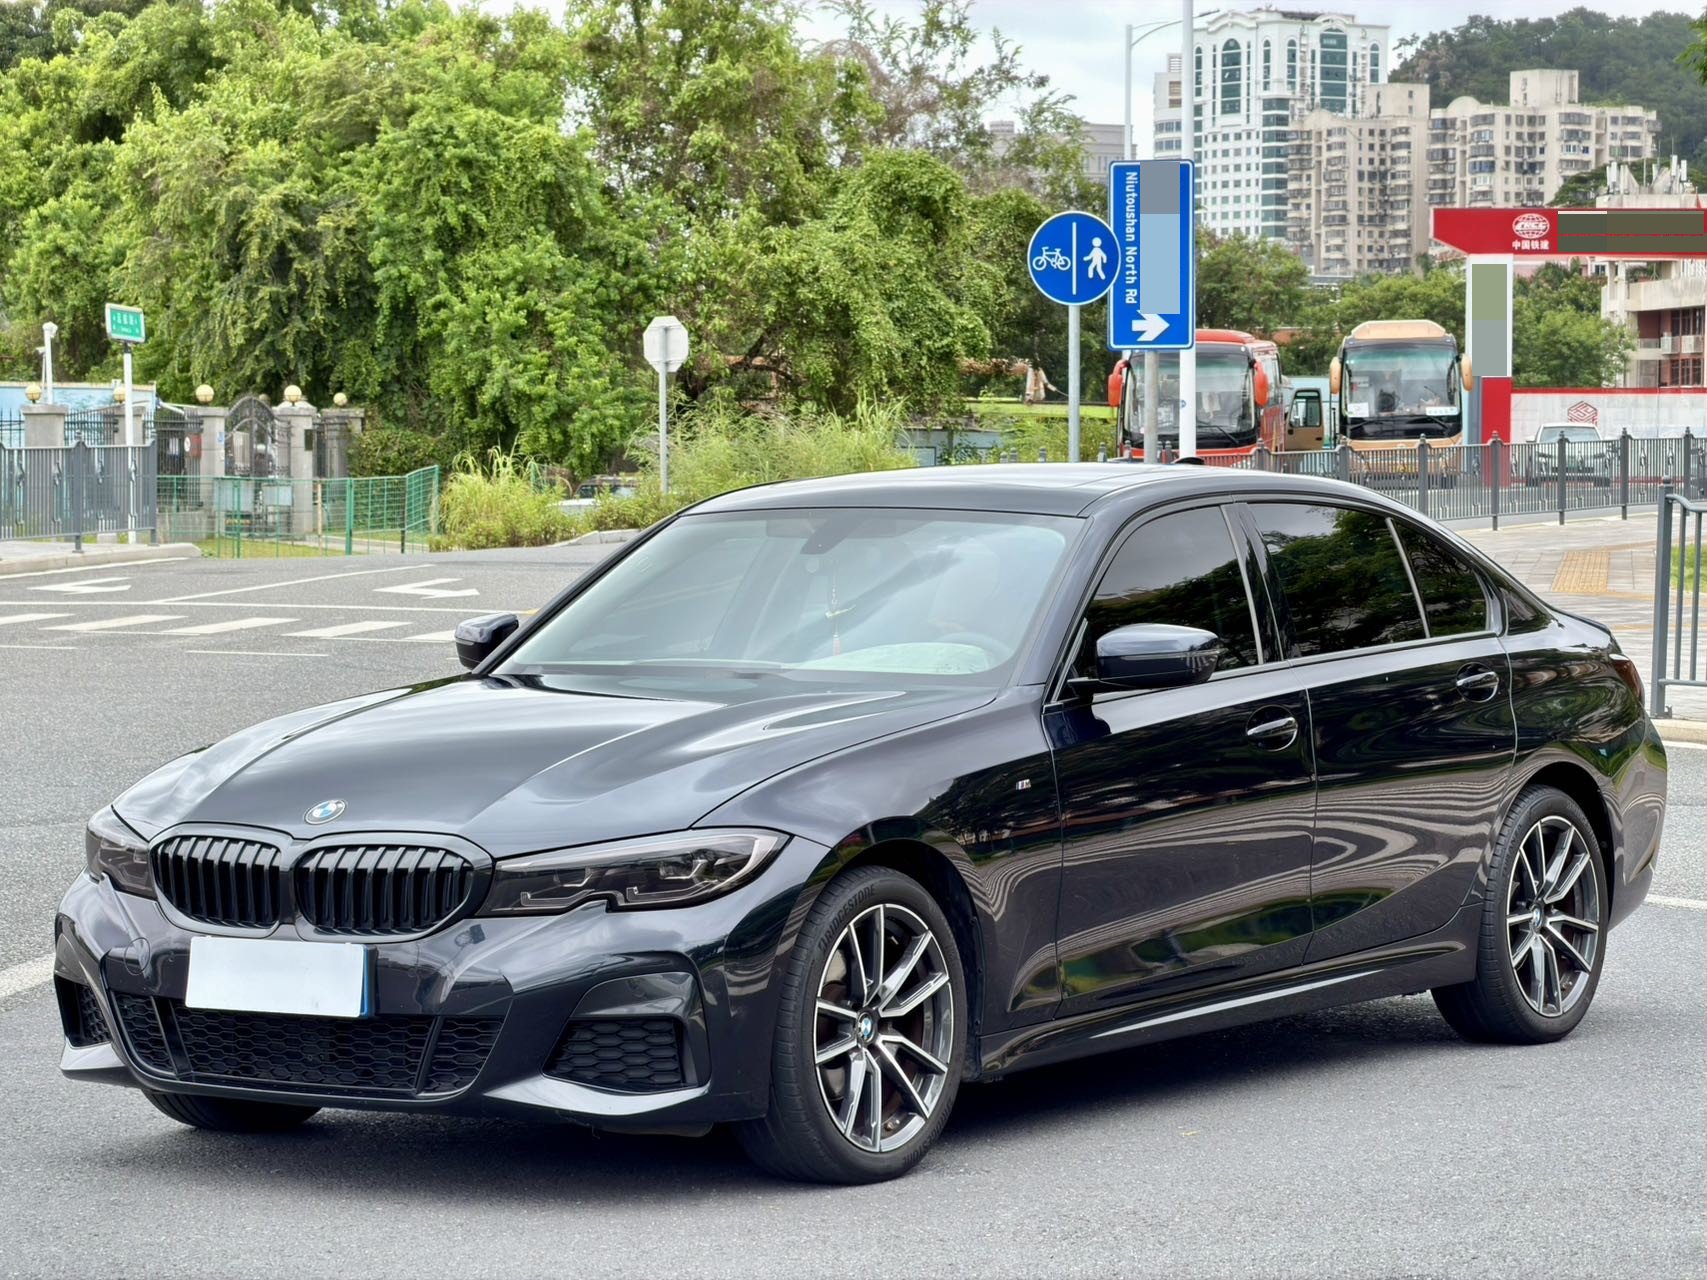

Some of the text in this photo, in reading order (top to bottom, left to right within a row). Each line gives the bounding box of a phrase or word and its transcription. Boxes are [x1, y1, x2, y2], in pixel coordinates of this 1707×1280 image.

[1125, 172, 1138, 304] Niutoushan North Rd
[1512, 240, 1549, 250] 中国铁建
